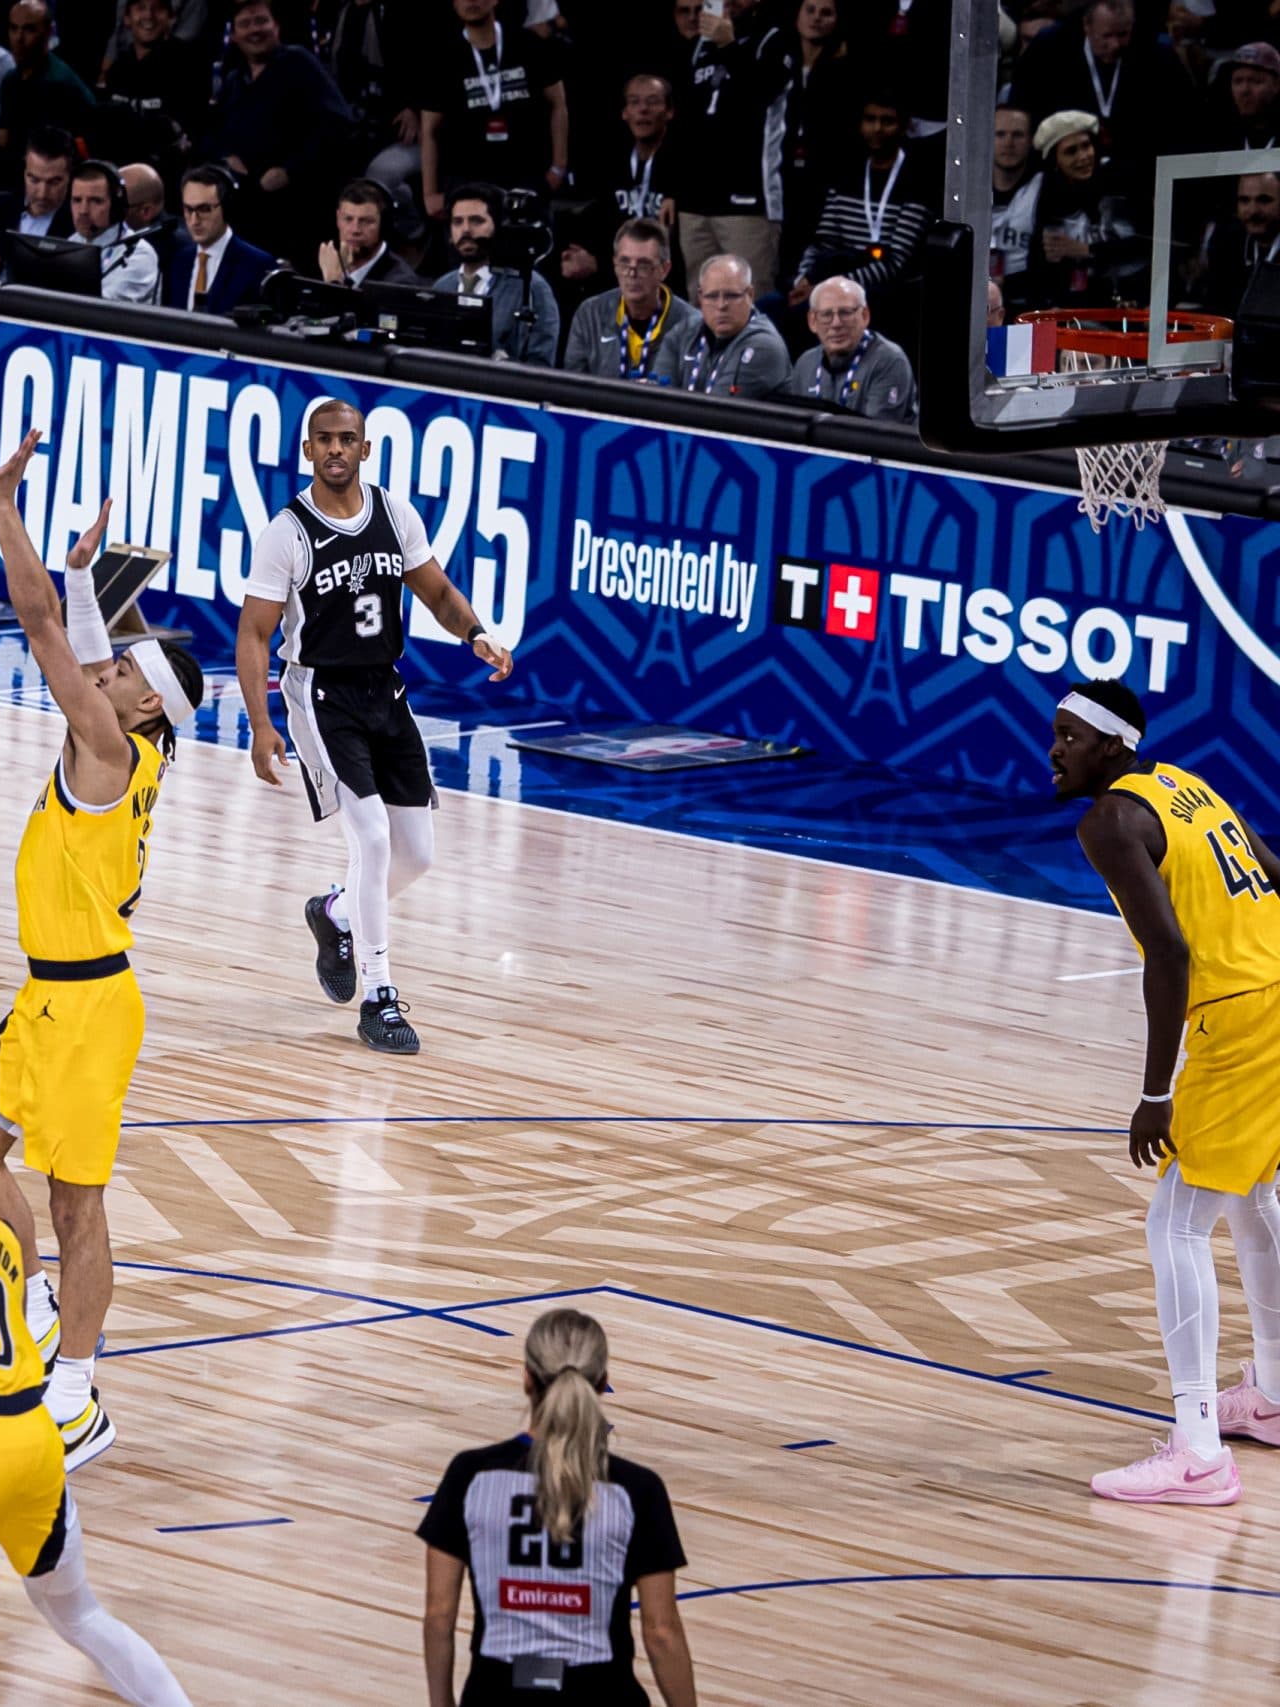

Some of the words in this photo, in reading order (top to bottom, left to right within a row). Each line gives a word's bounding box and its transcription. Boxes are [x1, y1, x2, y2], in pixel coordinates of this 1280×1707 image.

[298, 396, 538, 651] 25
[354, 593, 383, 638] 3
[570, 518, 719, 615] Presented
[720, 543, 758, 633] by
[889, 573, 1189, 693] TISSOT
[1205, 820, 1276, 902] 43
[506, 1584, 584, 1609] Emirates
